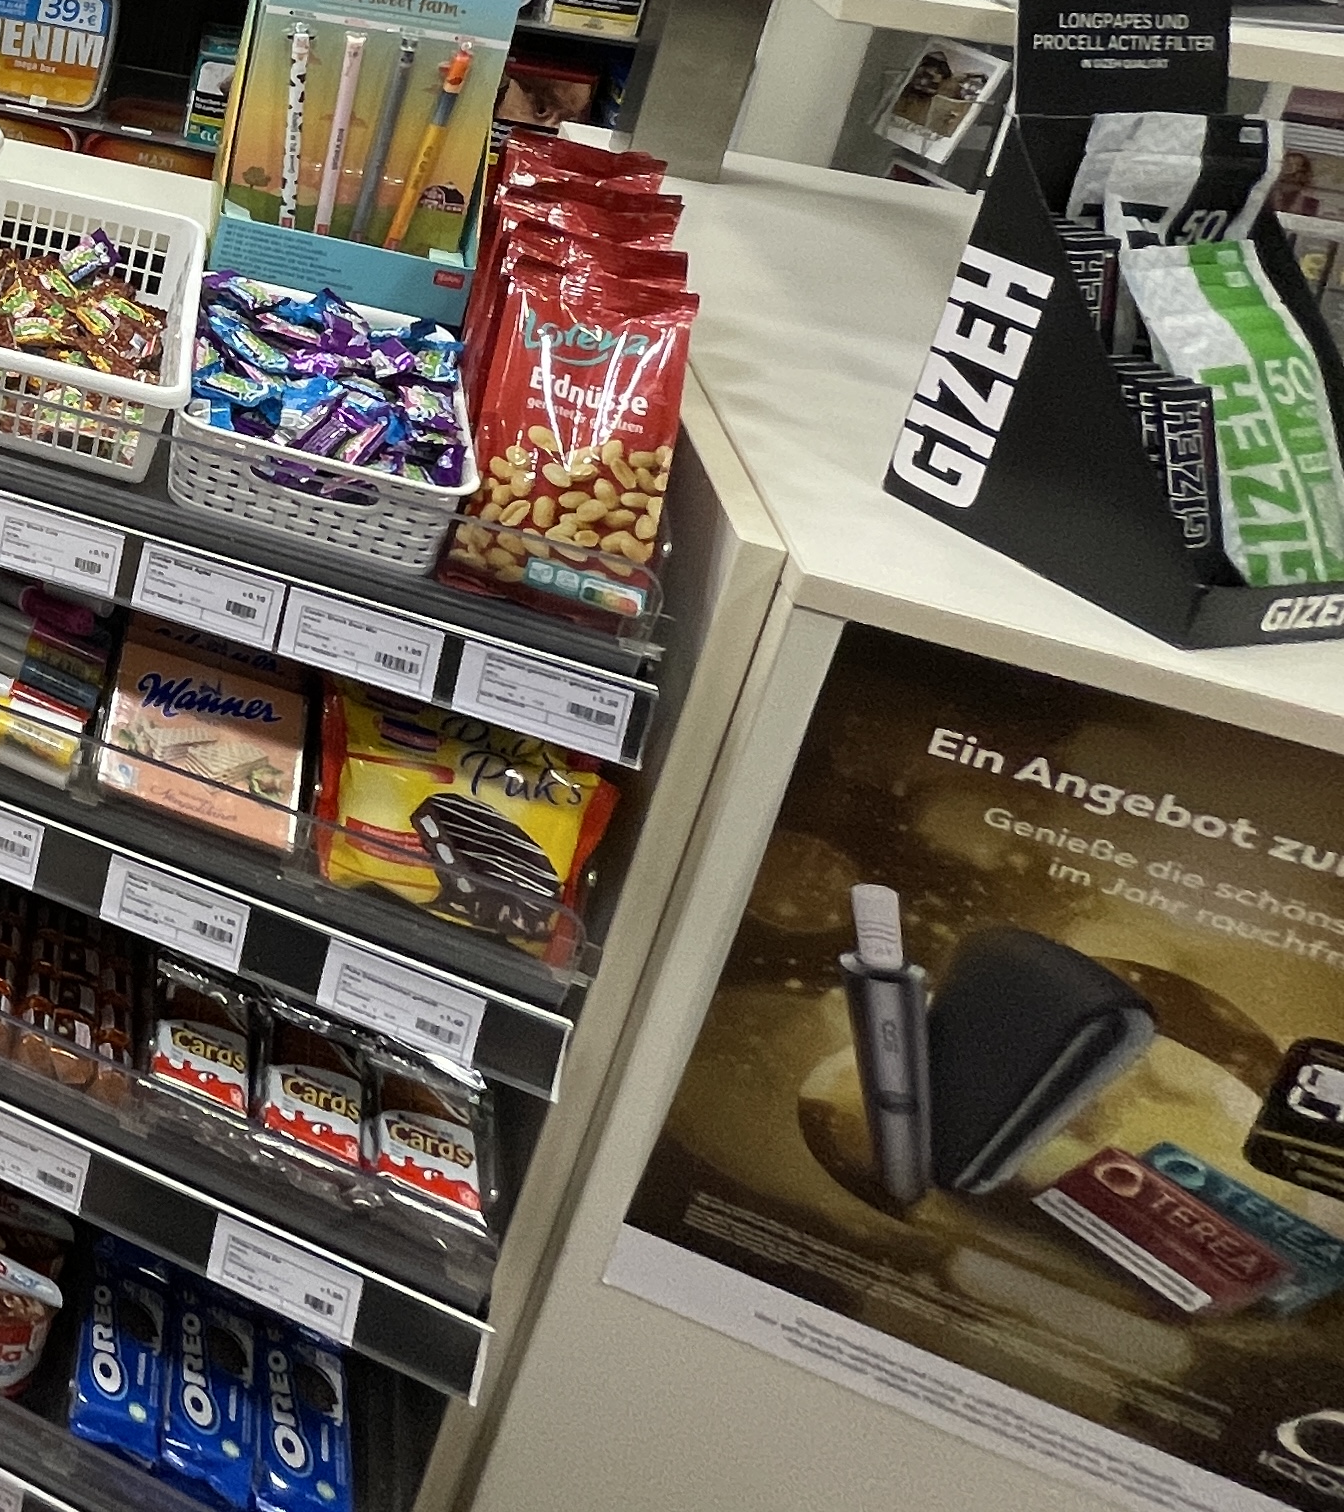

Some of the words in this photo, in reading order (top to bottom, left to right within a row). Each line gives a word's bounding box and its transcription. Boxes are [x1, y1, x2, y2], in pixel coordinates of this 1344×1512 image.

[1033, 34, 1105, 51] PROCELL
[1110, 34, 1162, 51] ACTIVE
[1164, 35, 1216, 51] FILTER
[1059, 13, 1153, 30] LONGPAPES
[1155, 14, 1190, 29] UND
[529, 366, 649, 416] Ednüse
[893, 242, 1056, 509] GIZEH
[1262, 357, 1313, 406] 50
[138, 672, 283, 722] Manner
[927, 727, 1004, 775] Ein
[1014, 756, 1258, 850] Angebot
[983, 807, 1138, 870] Genieße
[1147, 860, 1206, 889] die
[1048, 860, 1091, 887] im
[1101, 878, 1188, 915] Jahr
[174, 1027, 246, 1071] Cards
[284, 1073, 361, 1120] Cards
[391, 1118, 475, 1167] Cards
[1147, 1189, 1264, 1281] TEREA
[89, 1285, 123, 1396] OREO
[180, 1311, 215, 1428] OREO
[264, 1350, 309, 1471] OREO
